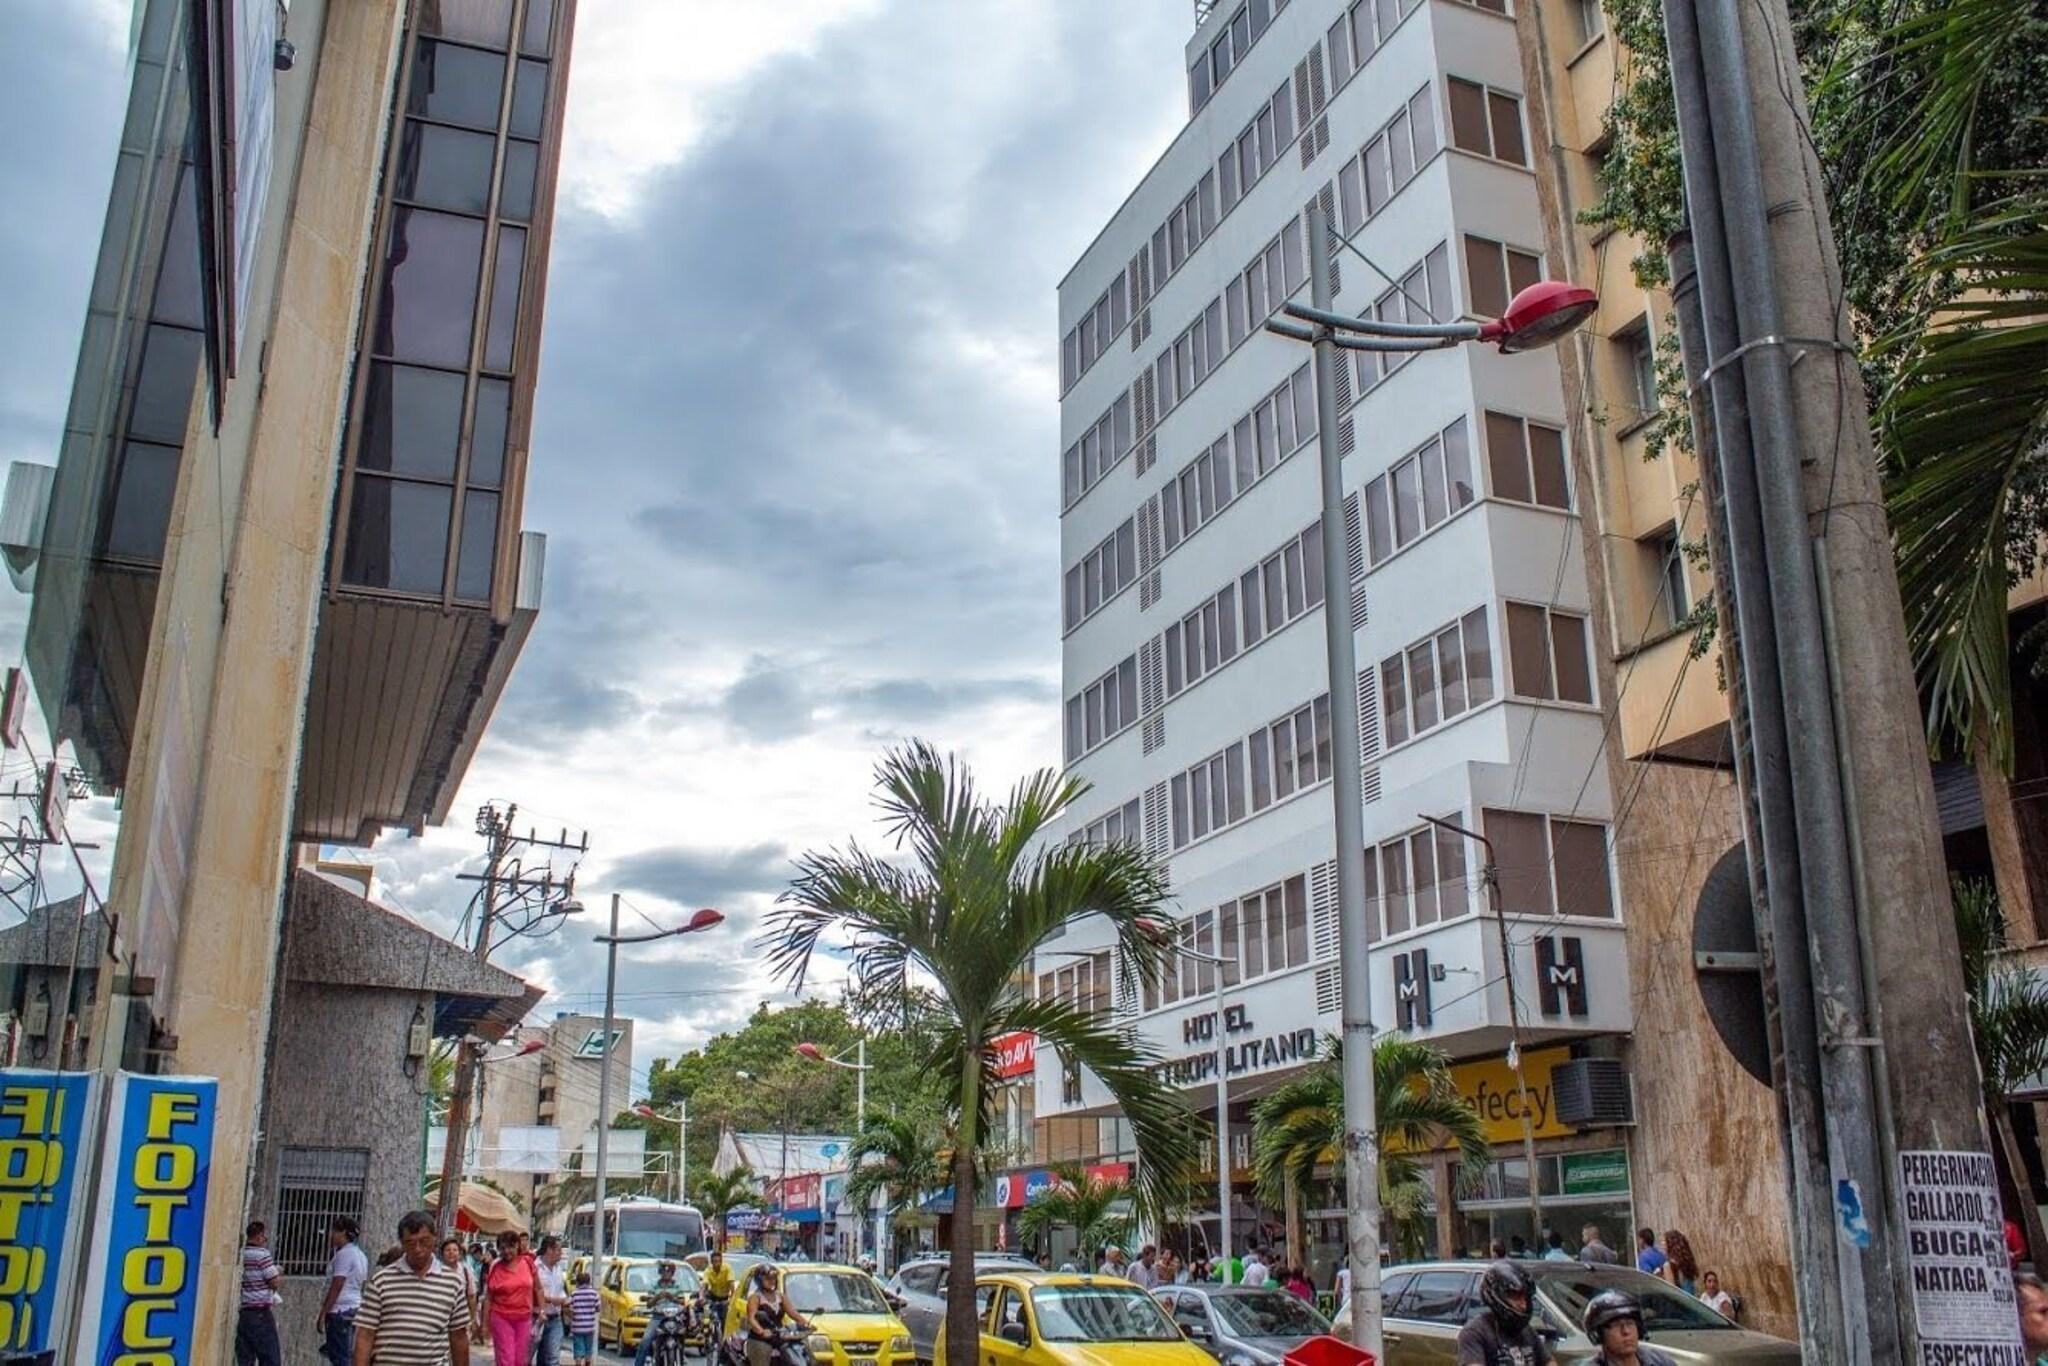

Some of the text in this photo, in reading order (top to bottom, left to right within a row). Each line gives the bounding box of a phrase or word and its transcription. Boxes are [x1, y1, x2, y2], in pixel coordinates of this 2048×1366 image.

[1153, 1028, 1316, 1086] TROPLITANO
[1906, 1191, 1984, 1223] GALLARDO
[1911, 1231, 1984, 1256] BUGA
[1914, 1266, 1988, 1293] NATAGA
